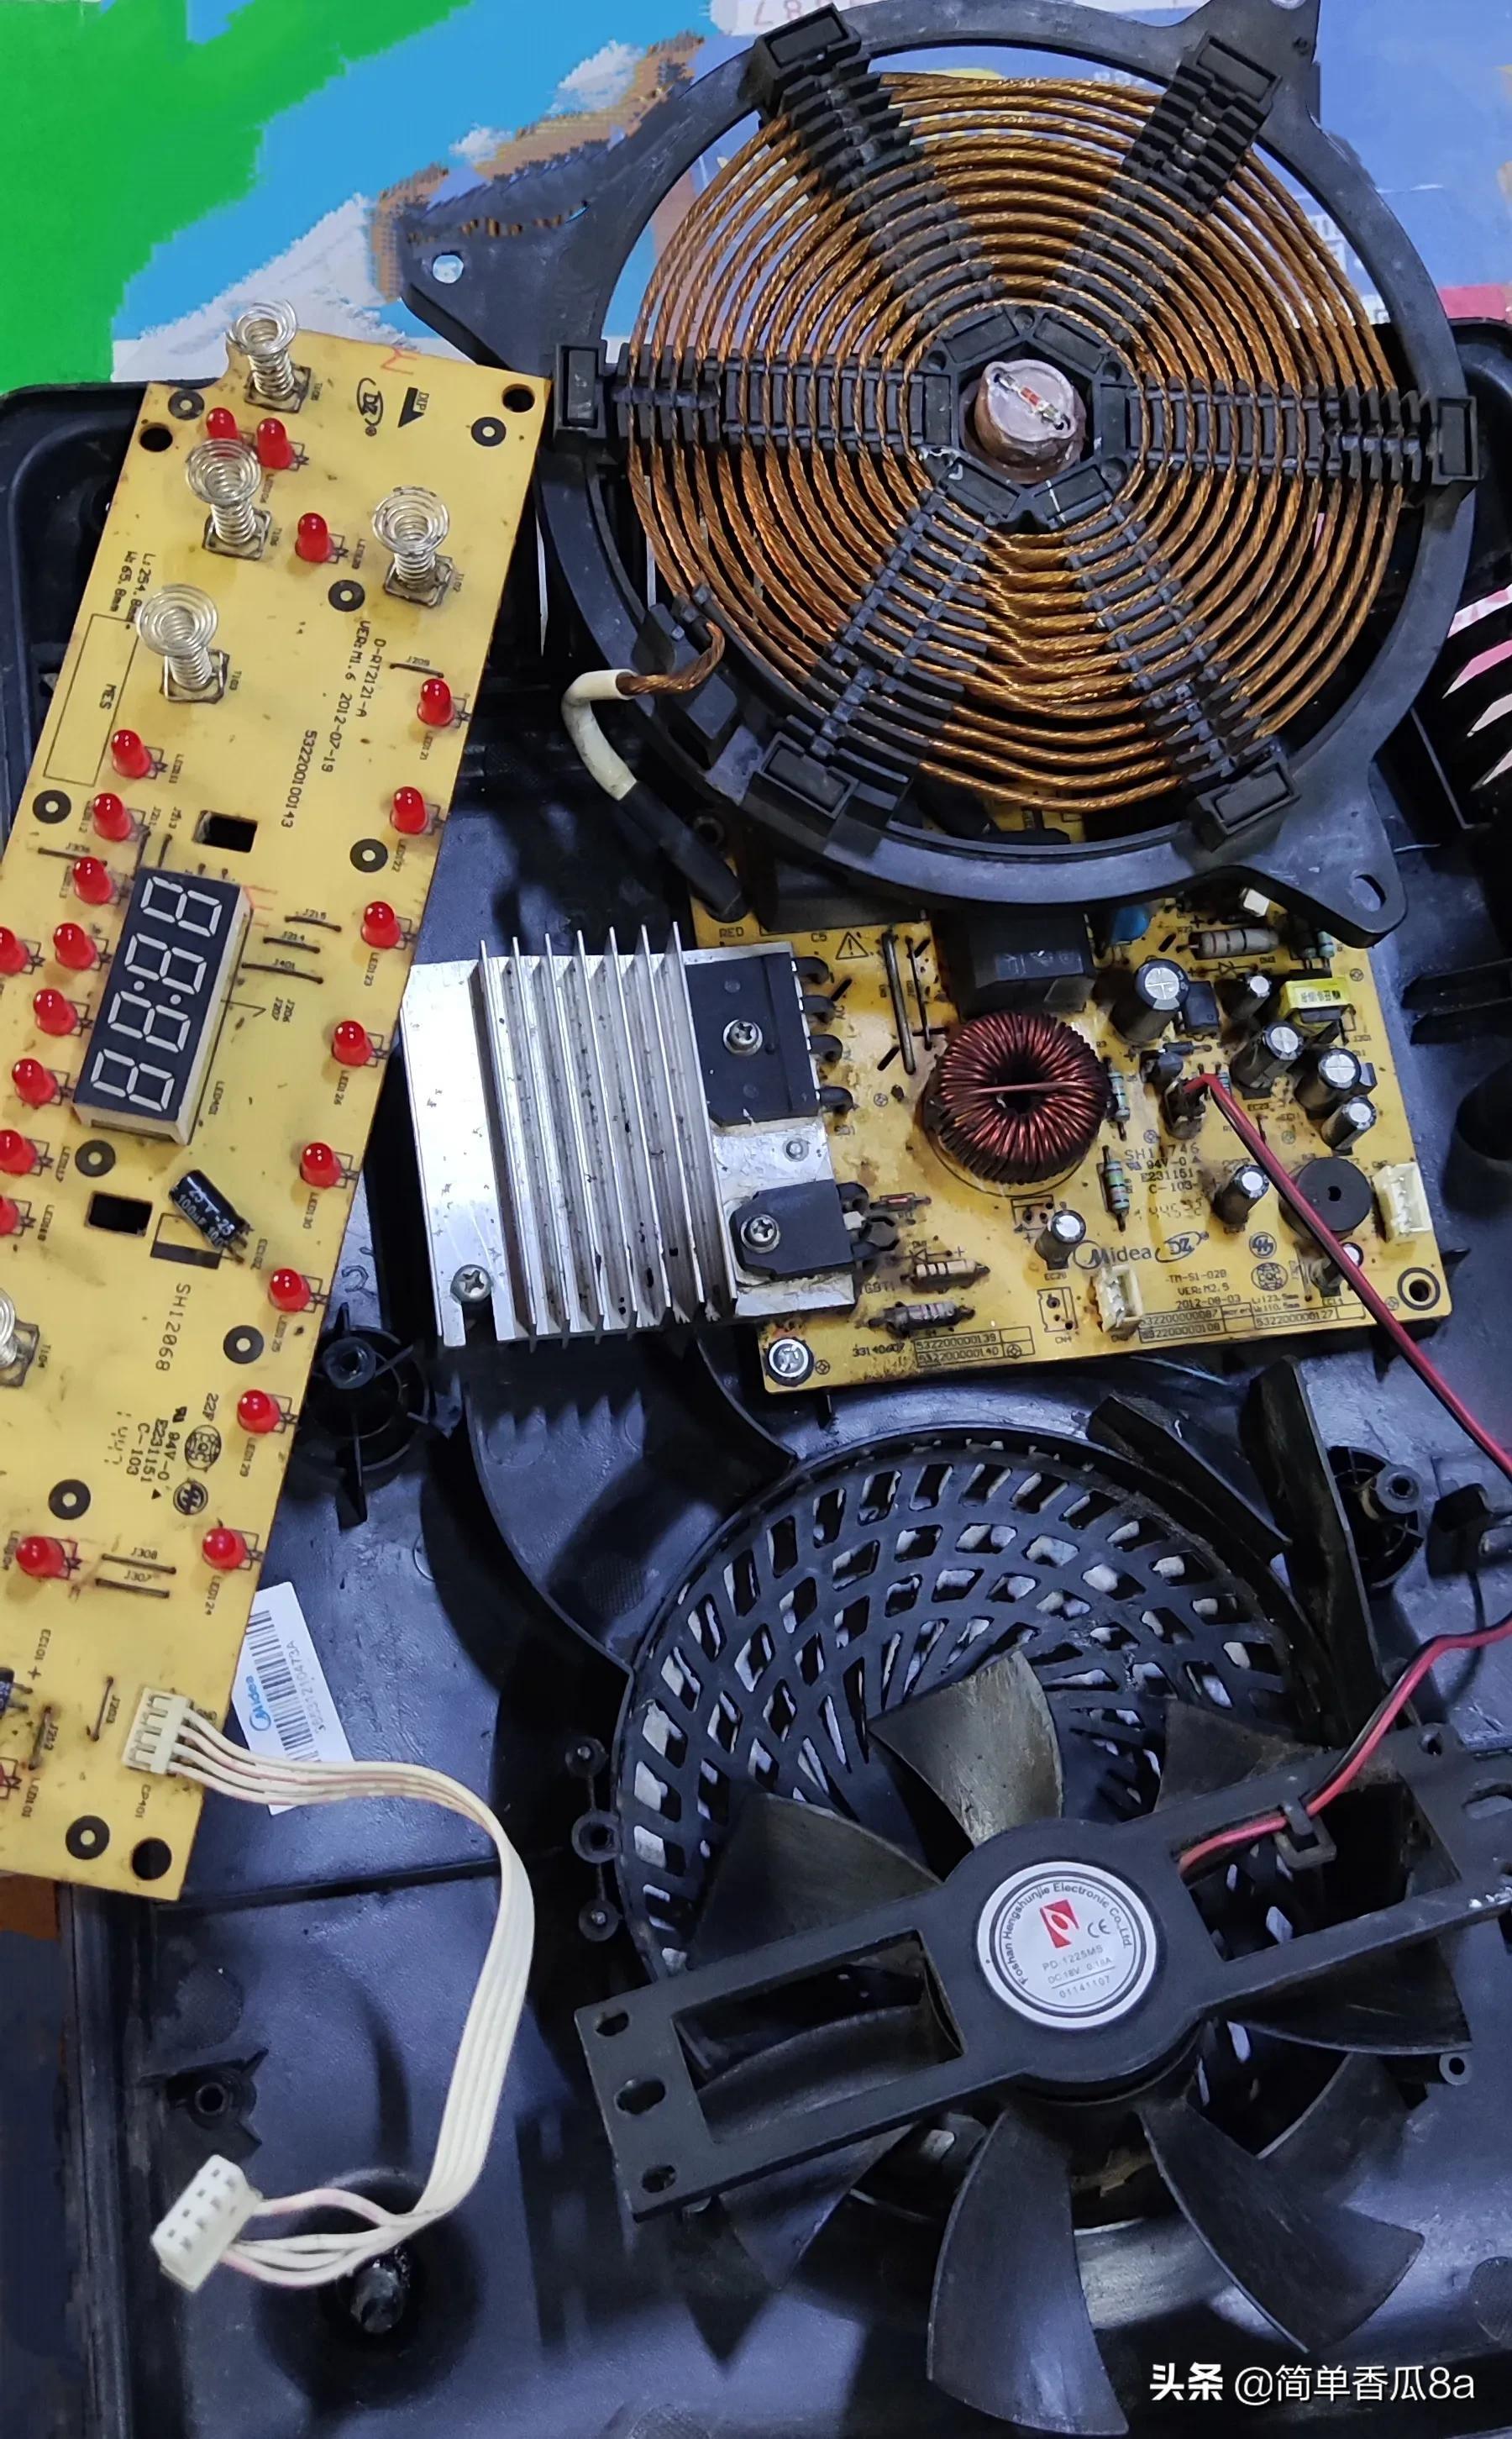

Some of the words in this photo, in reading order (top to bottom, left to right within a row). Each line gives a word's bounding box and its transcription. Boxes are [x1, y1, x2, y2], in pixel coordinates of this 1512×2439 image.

[415, 392, 430, 411] DIP
[98, 683, 117, 710] MES
[321, 691, 353, 773] 2012-07-19
[281, 728, 318, 828] 532200100143
[718, 926, 745, 938] RED
[1080, 1242, 1152, 1268] Midea
[155, 1282, 192, 1372] SH12068
[139, 1417, 169, 1484] E231151
[245, 1675, 271, 1732] Midea
[1002, 1885, 1051, 1940] Hengshunjie
[1053, 1881, 1110, 1909] Electronic
[1086, 1917, 1111, 1939] CE
[1002, 1942, 1029, 1985] Foshan
